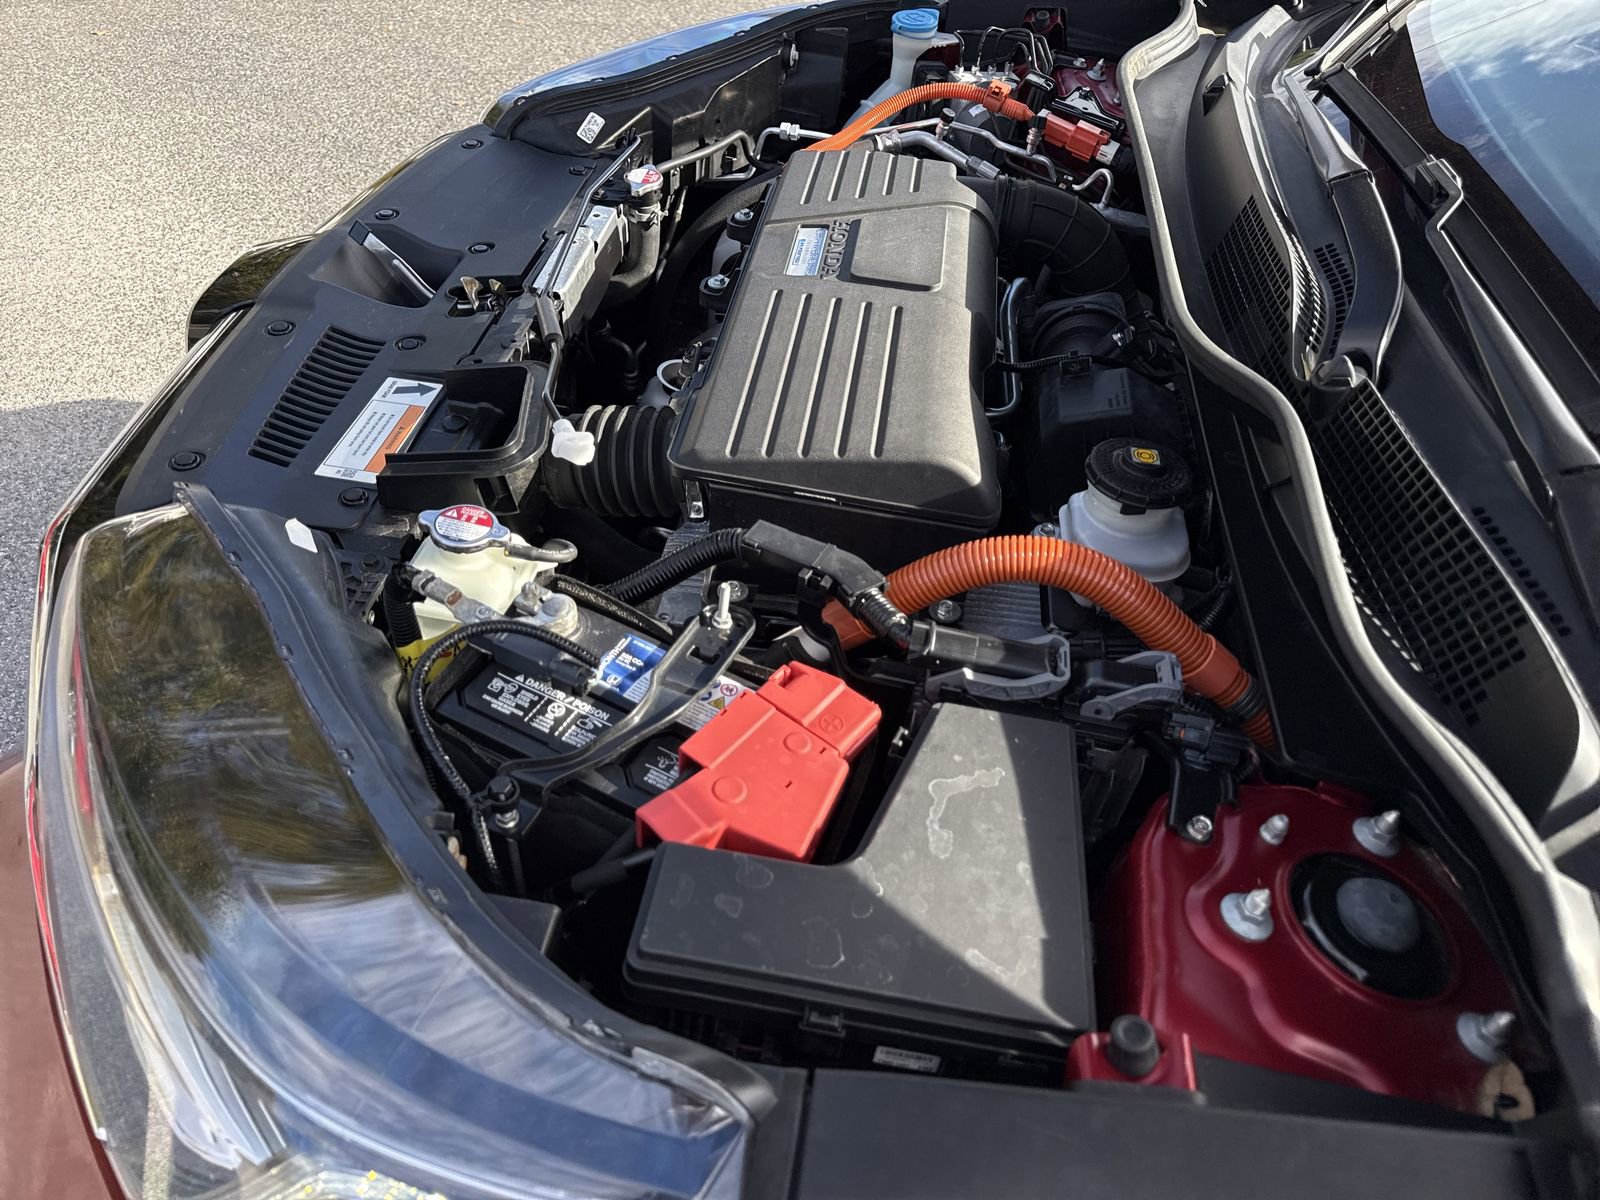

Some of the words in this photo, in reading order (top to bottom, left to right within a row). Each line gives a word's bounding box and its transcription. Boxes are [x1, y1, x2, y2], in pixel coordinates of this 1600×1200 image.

[820, 219, 850, 279] HONDA
[525, 678, 566, 701] DANGER
[572, 698, 611, 721] POISON
